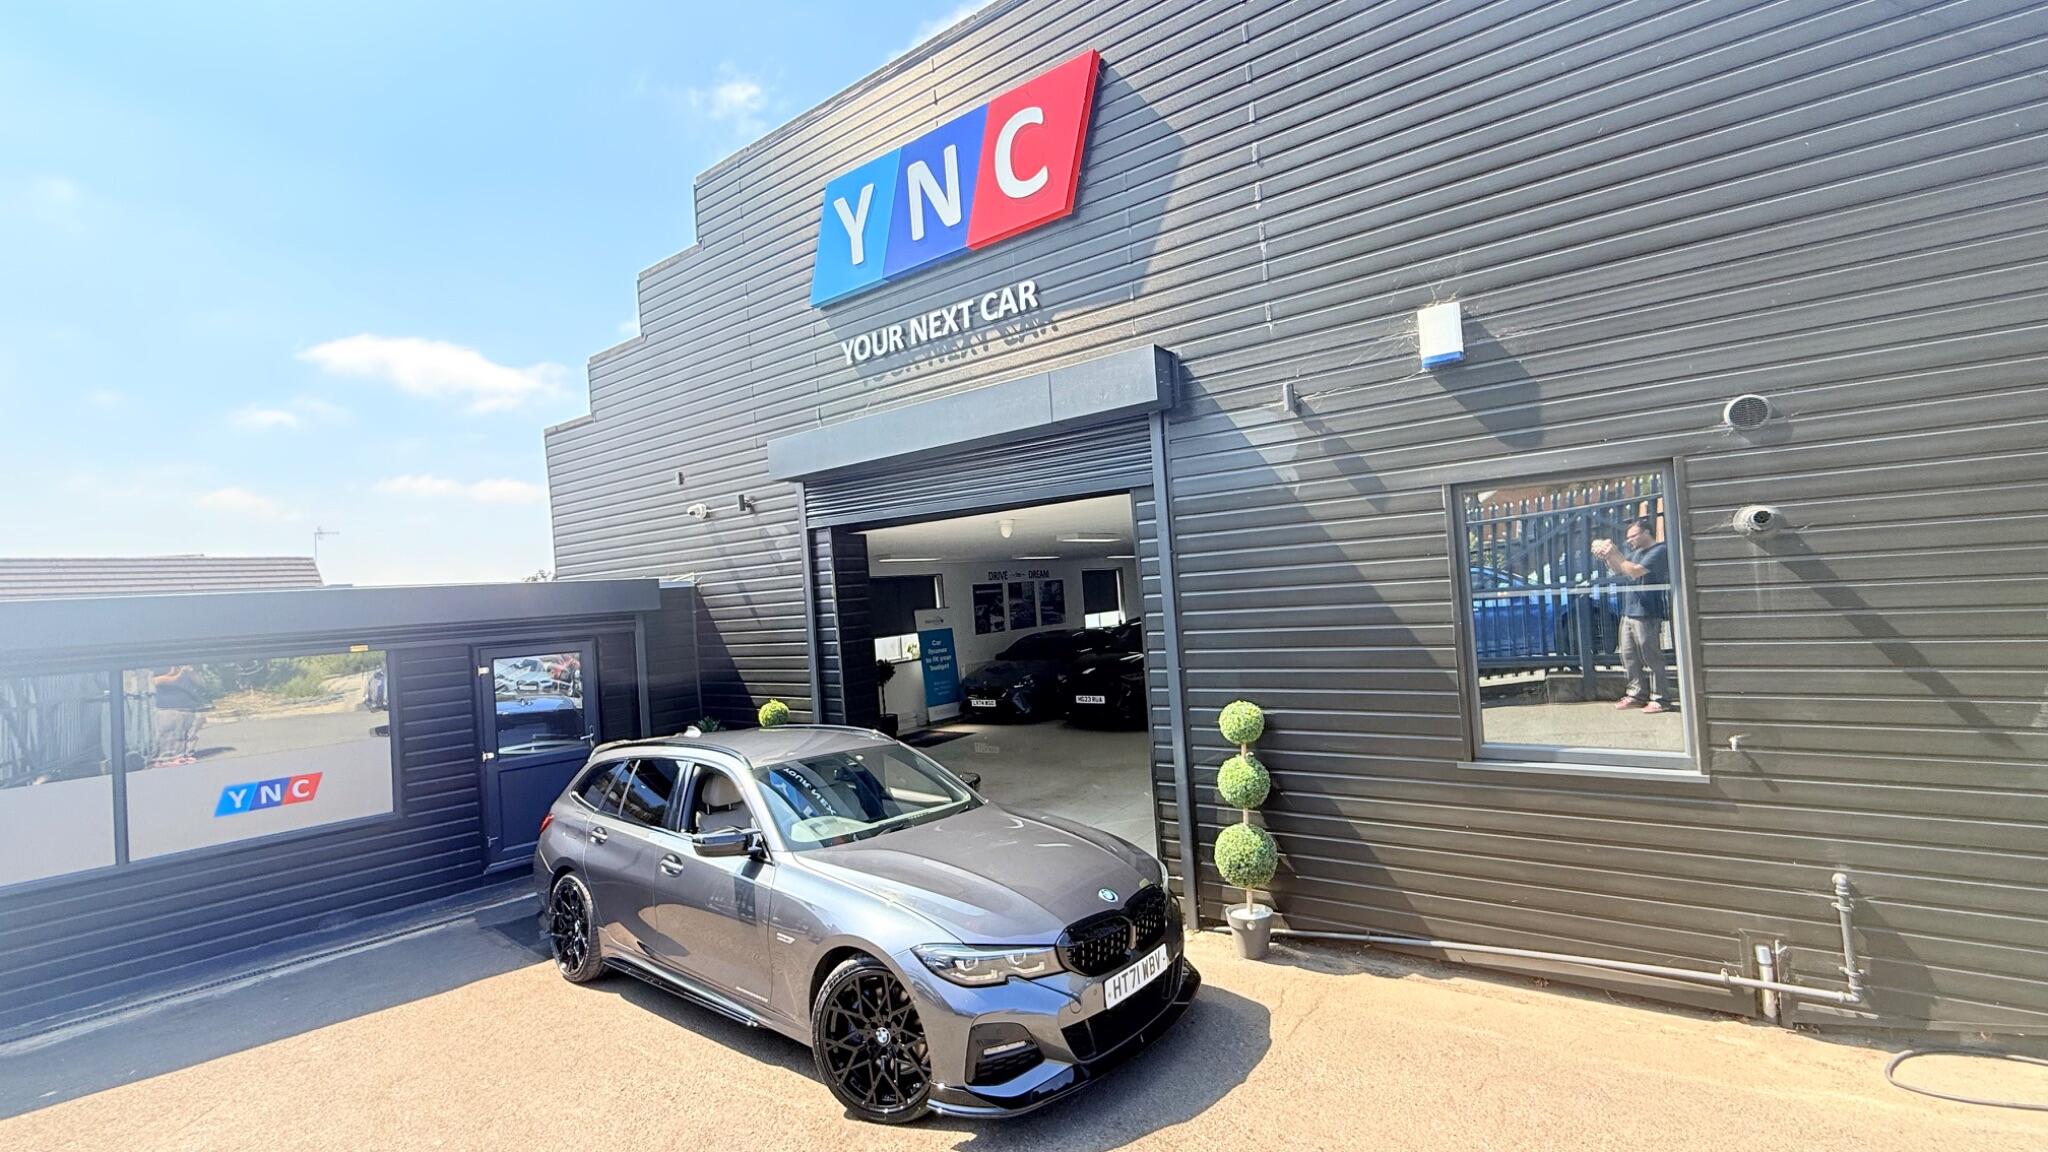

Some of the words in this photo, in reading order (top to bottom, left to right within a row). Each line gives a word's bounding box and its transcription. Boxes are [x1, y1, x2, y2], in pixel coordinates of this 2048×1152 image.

[833, 106, 1049, 265] YNC
[841, 324, 905, 365] YOUR
[909, 298, 974, 345] NEXT
[980, 280, 1039, 321] CAR
[988, 570, 1008, 580] DRIVE
[1028, 569, 1050, 579] DREAM
[228, 779, 310, 809] YNC
[1113, 967, 1140, 999] HT71
[1142, 950, 1161, 981] WBV
